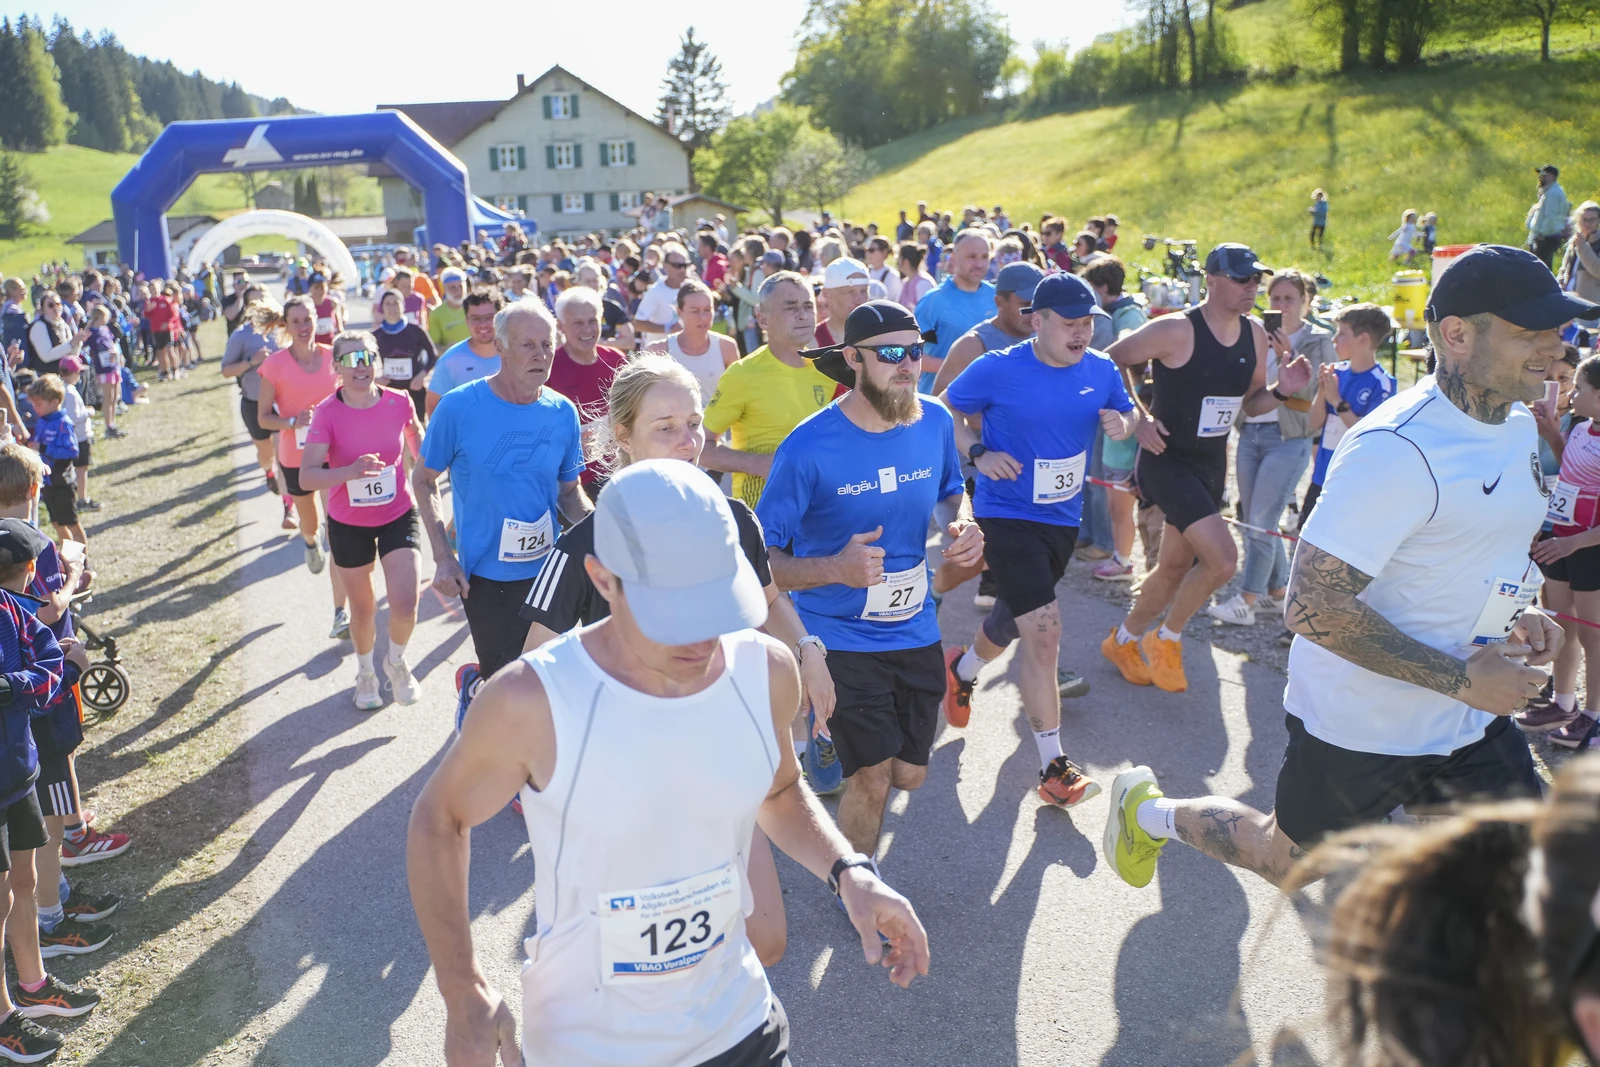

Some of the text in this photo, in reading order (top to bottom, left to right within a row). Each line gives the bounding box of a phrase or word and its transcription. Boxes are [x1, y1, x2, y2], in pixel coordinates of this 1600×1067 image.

[1217, 411, 1232, 425] 73
[837, 480, 878, 496] allgäu
[1055, 472, 1074, 490] 33
[365, 482, 383, 496] 16
[517, 531, 546, 551] 124
[888, 586, 915, 608] 27
[721, 877, 731, 887] eG
[640, 889, 680, 902] Volksbank
[640, 910, 712, 956] 123
[634, 963, 662, 972] VBAO
